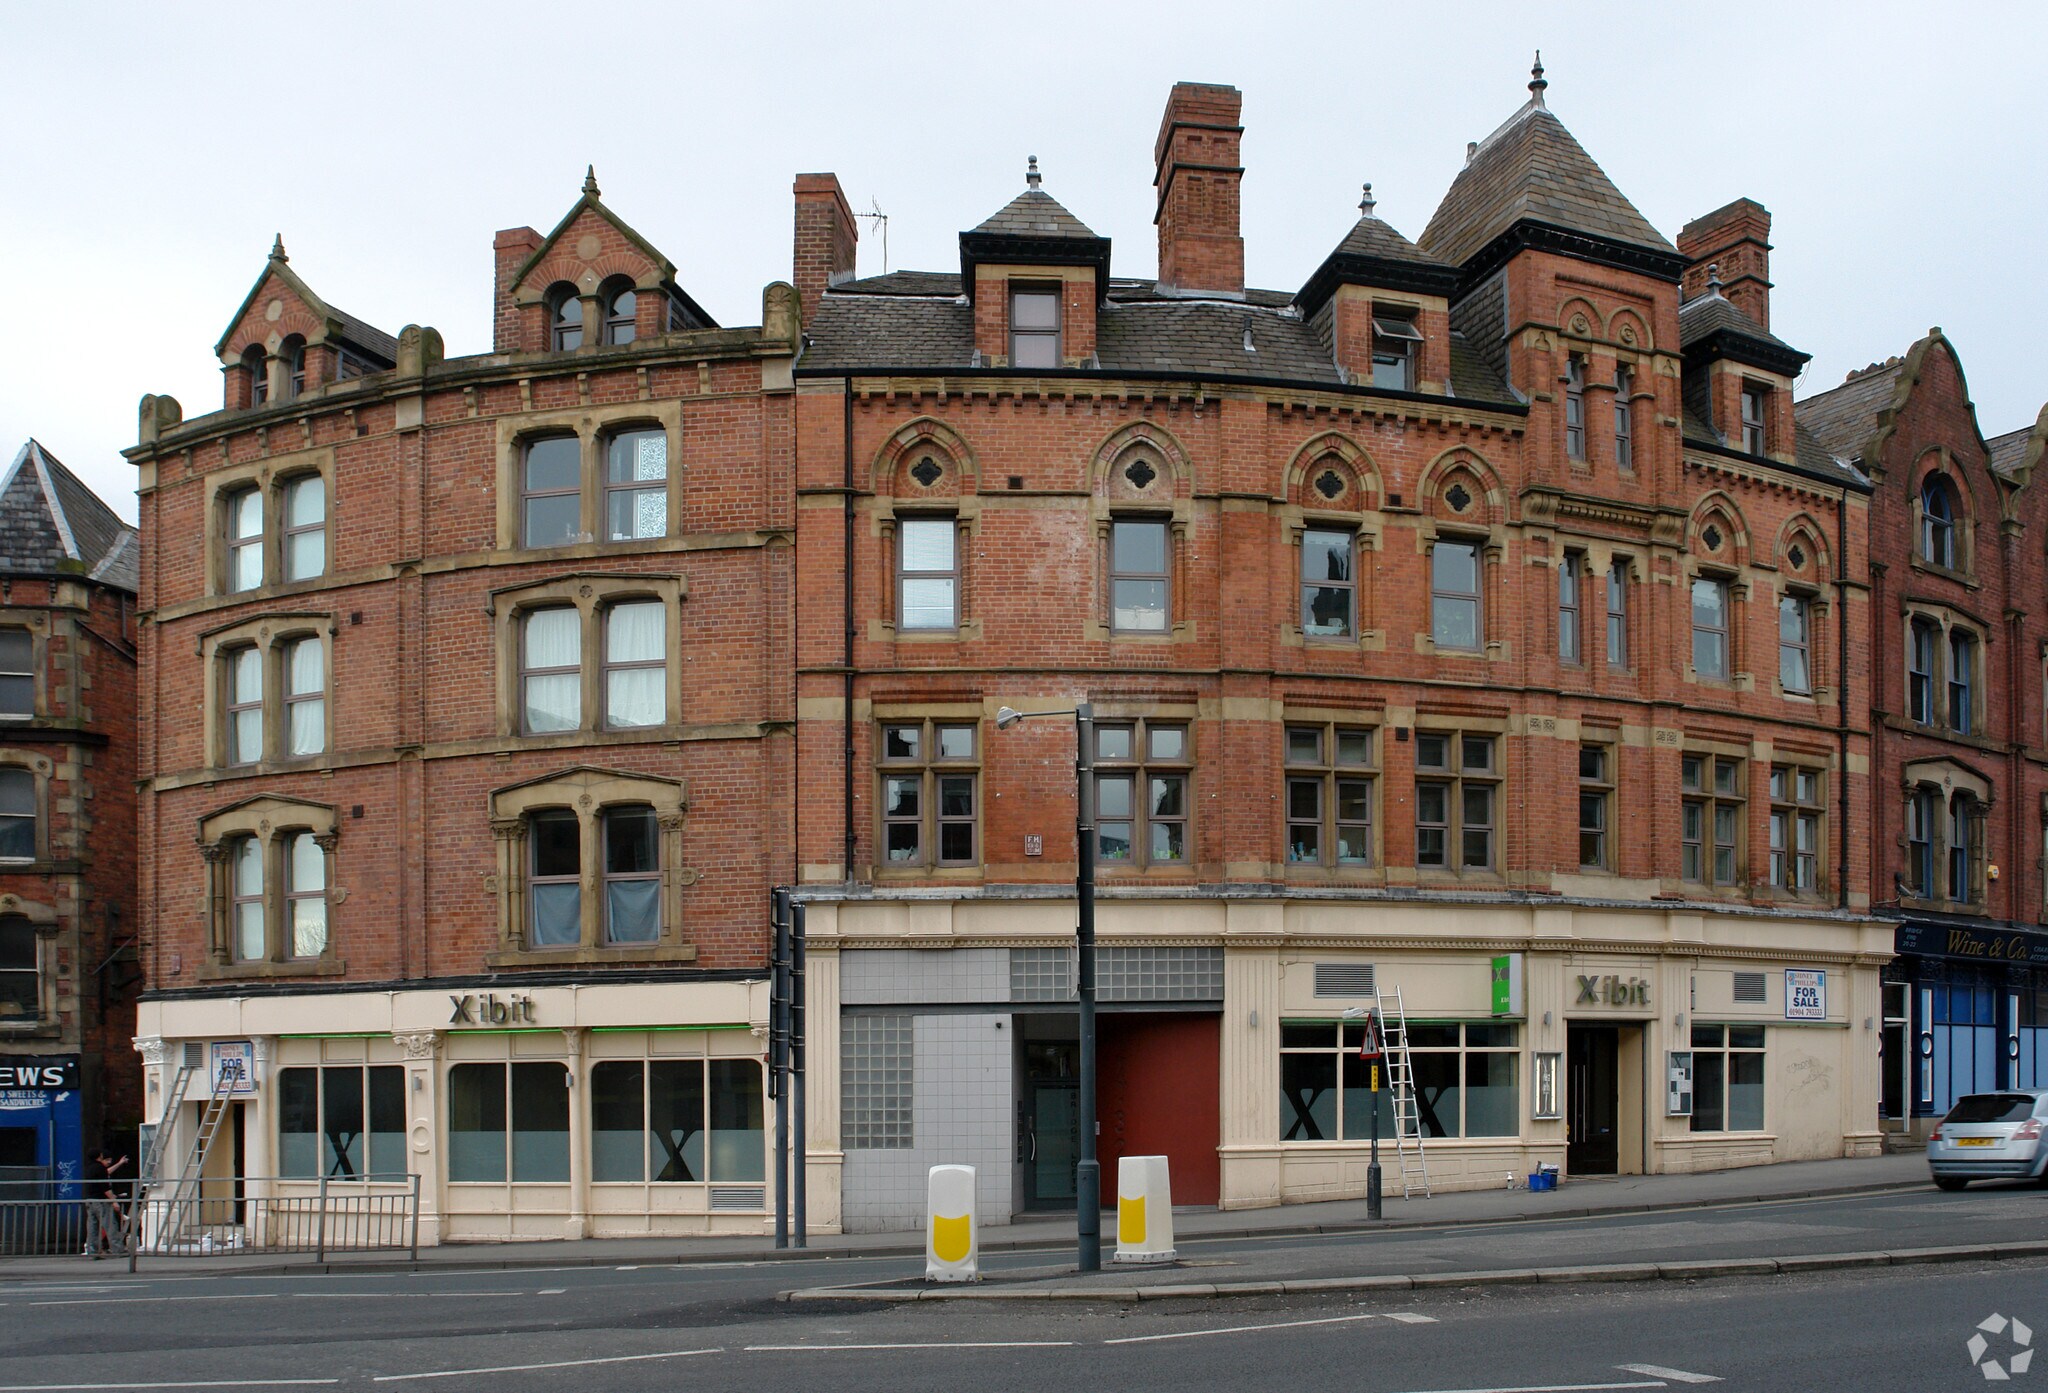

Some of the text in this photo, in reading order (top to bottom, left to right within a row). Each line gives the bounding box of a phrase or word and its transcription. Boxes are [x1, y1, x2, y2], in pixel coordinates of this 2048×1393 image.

[1947, 929, 2027, 960] Wine & Co.
[1576, 974, 1652, 1006] Xibit
[1795, 987, 1817, 998] FOR
[449, 993, 537, 1024] Xibit
[1793, 997, 1820, 1008] SALE
[7, 1090, 37, 1099] SWEETS
